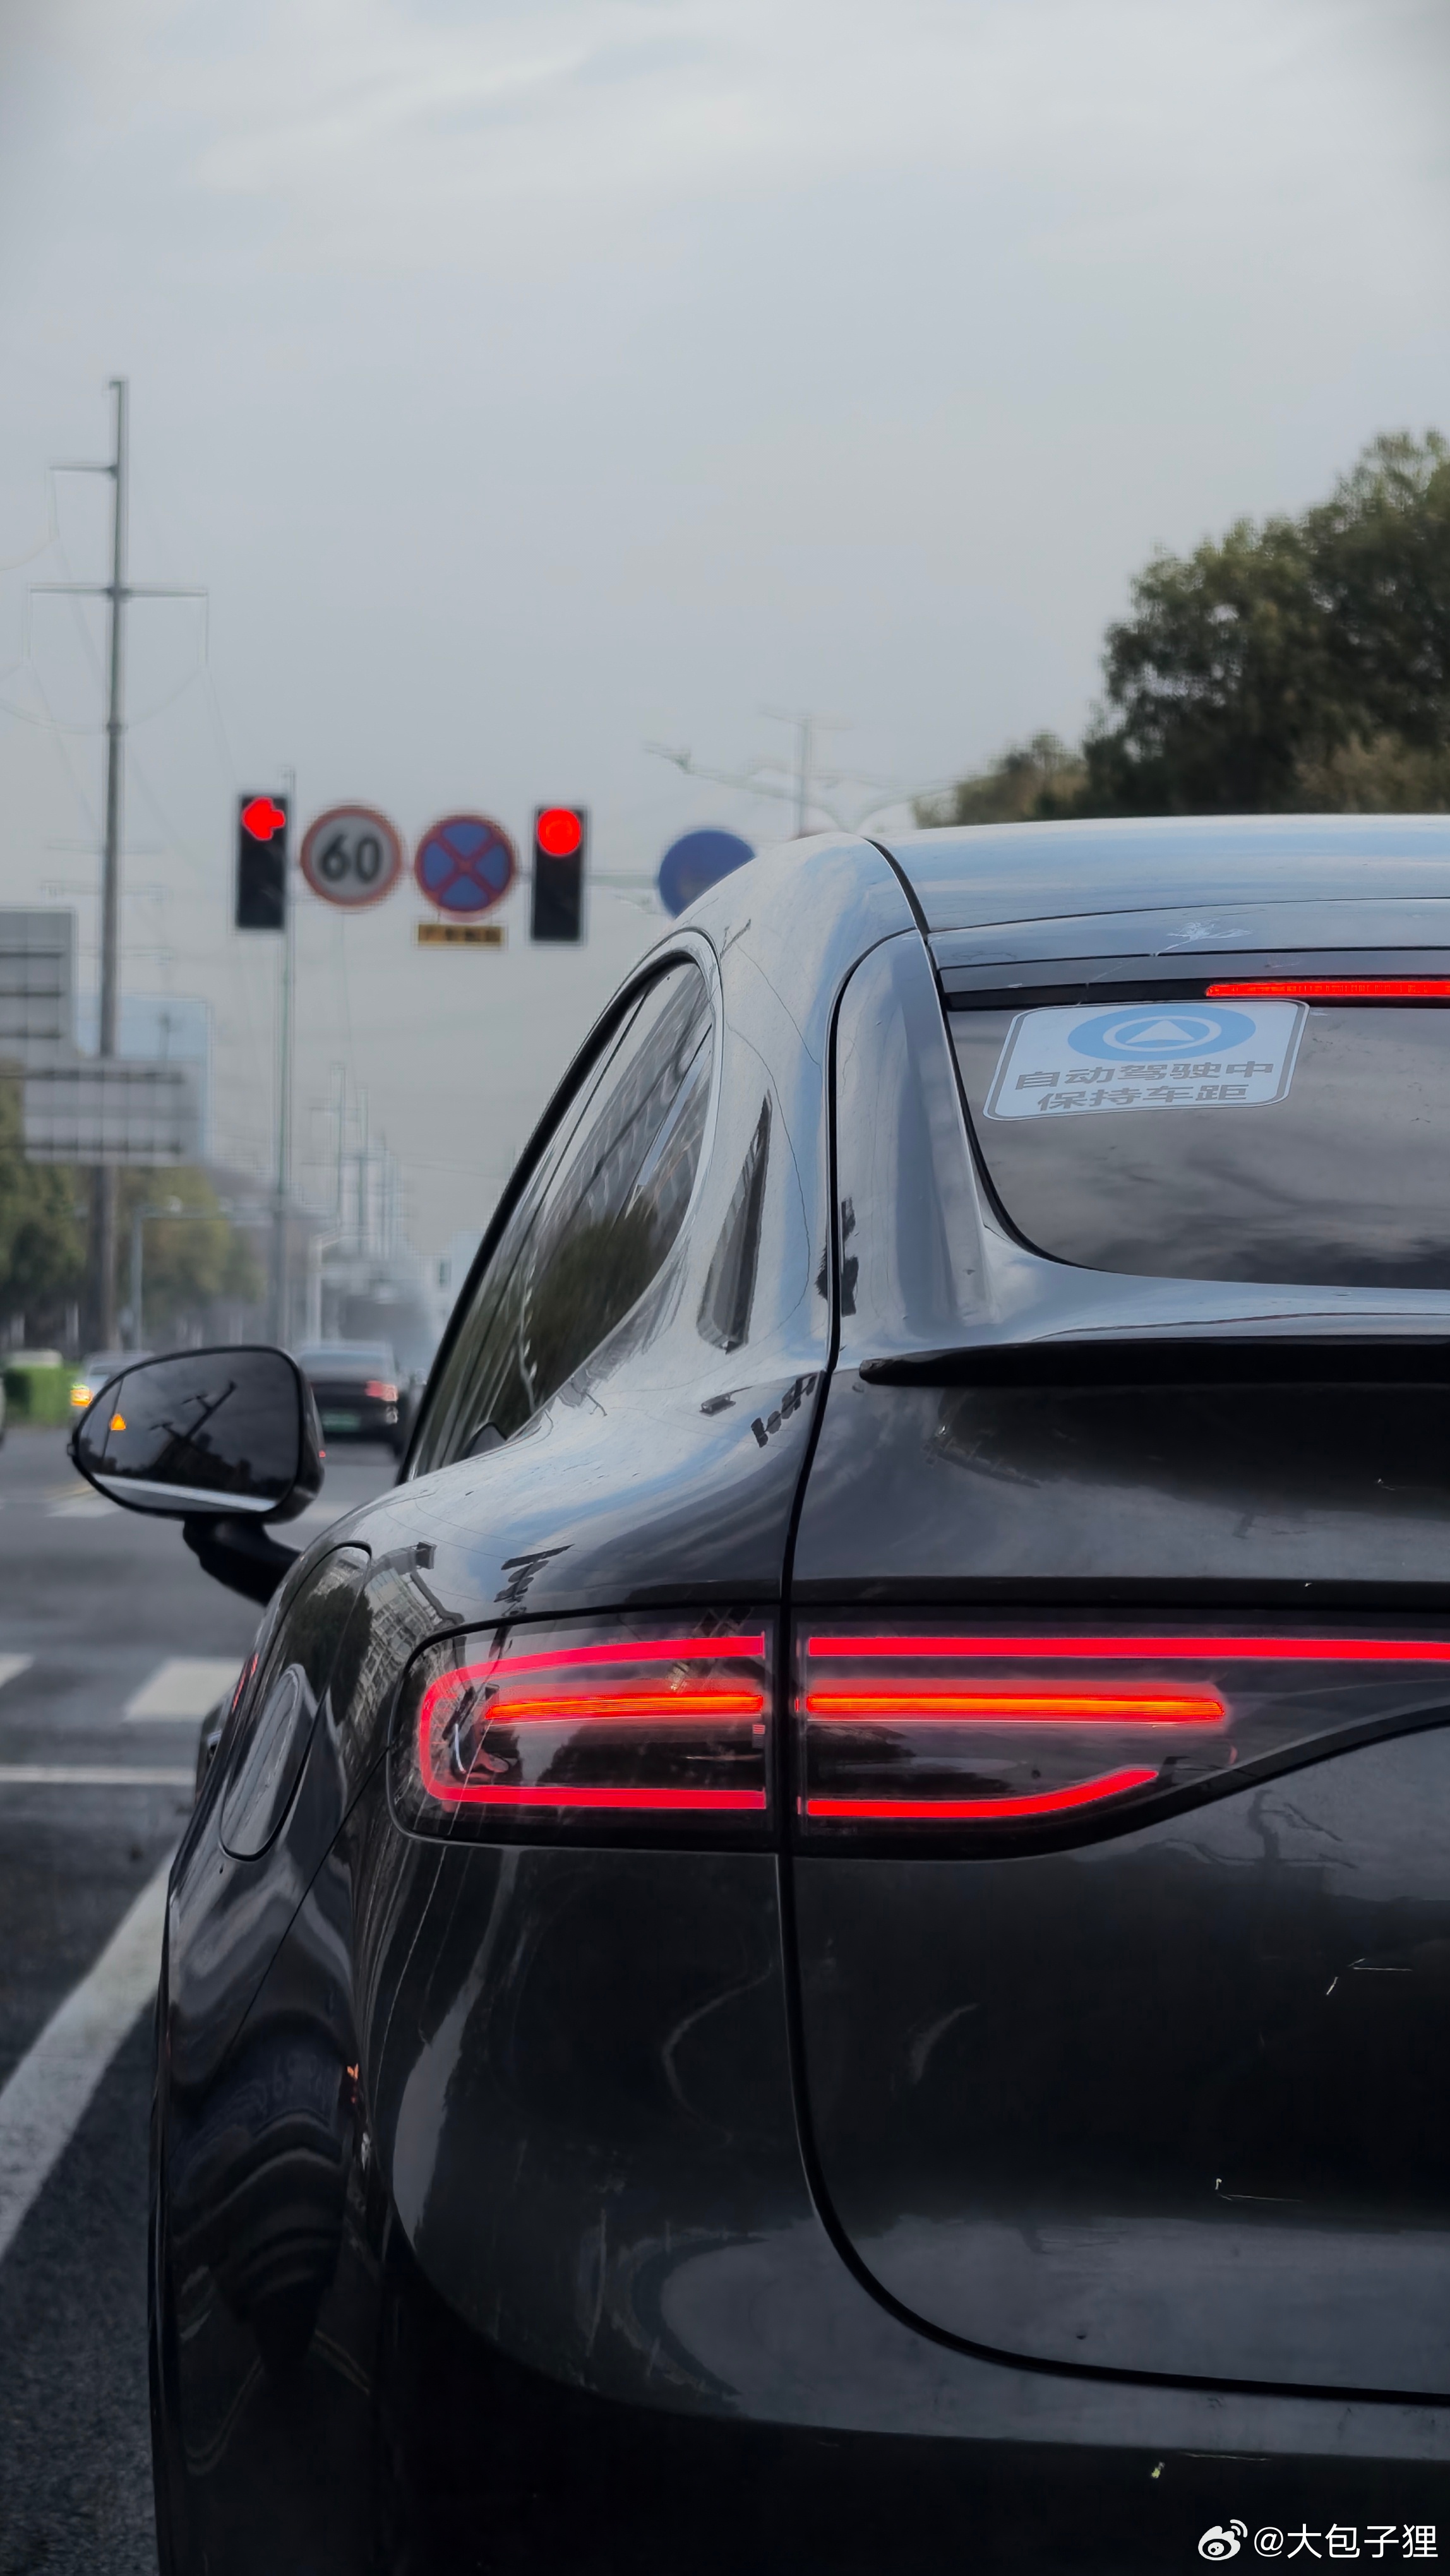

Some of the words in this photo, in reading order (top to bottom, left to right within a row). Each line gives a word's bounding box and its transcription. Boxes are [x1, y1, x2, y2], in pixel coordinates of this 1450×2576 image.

[320, 833, 383, 883] 60
[1015, 1061, 1274, 1090] 自动驾驶中
[1037, 1084, 1249, 1111] 保持车距
